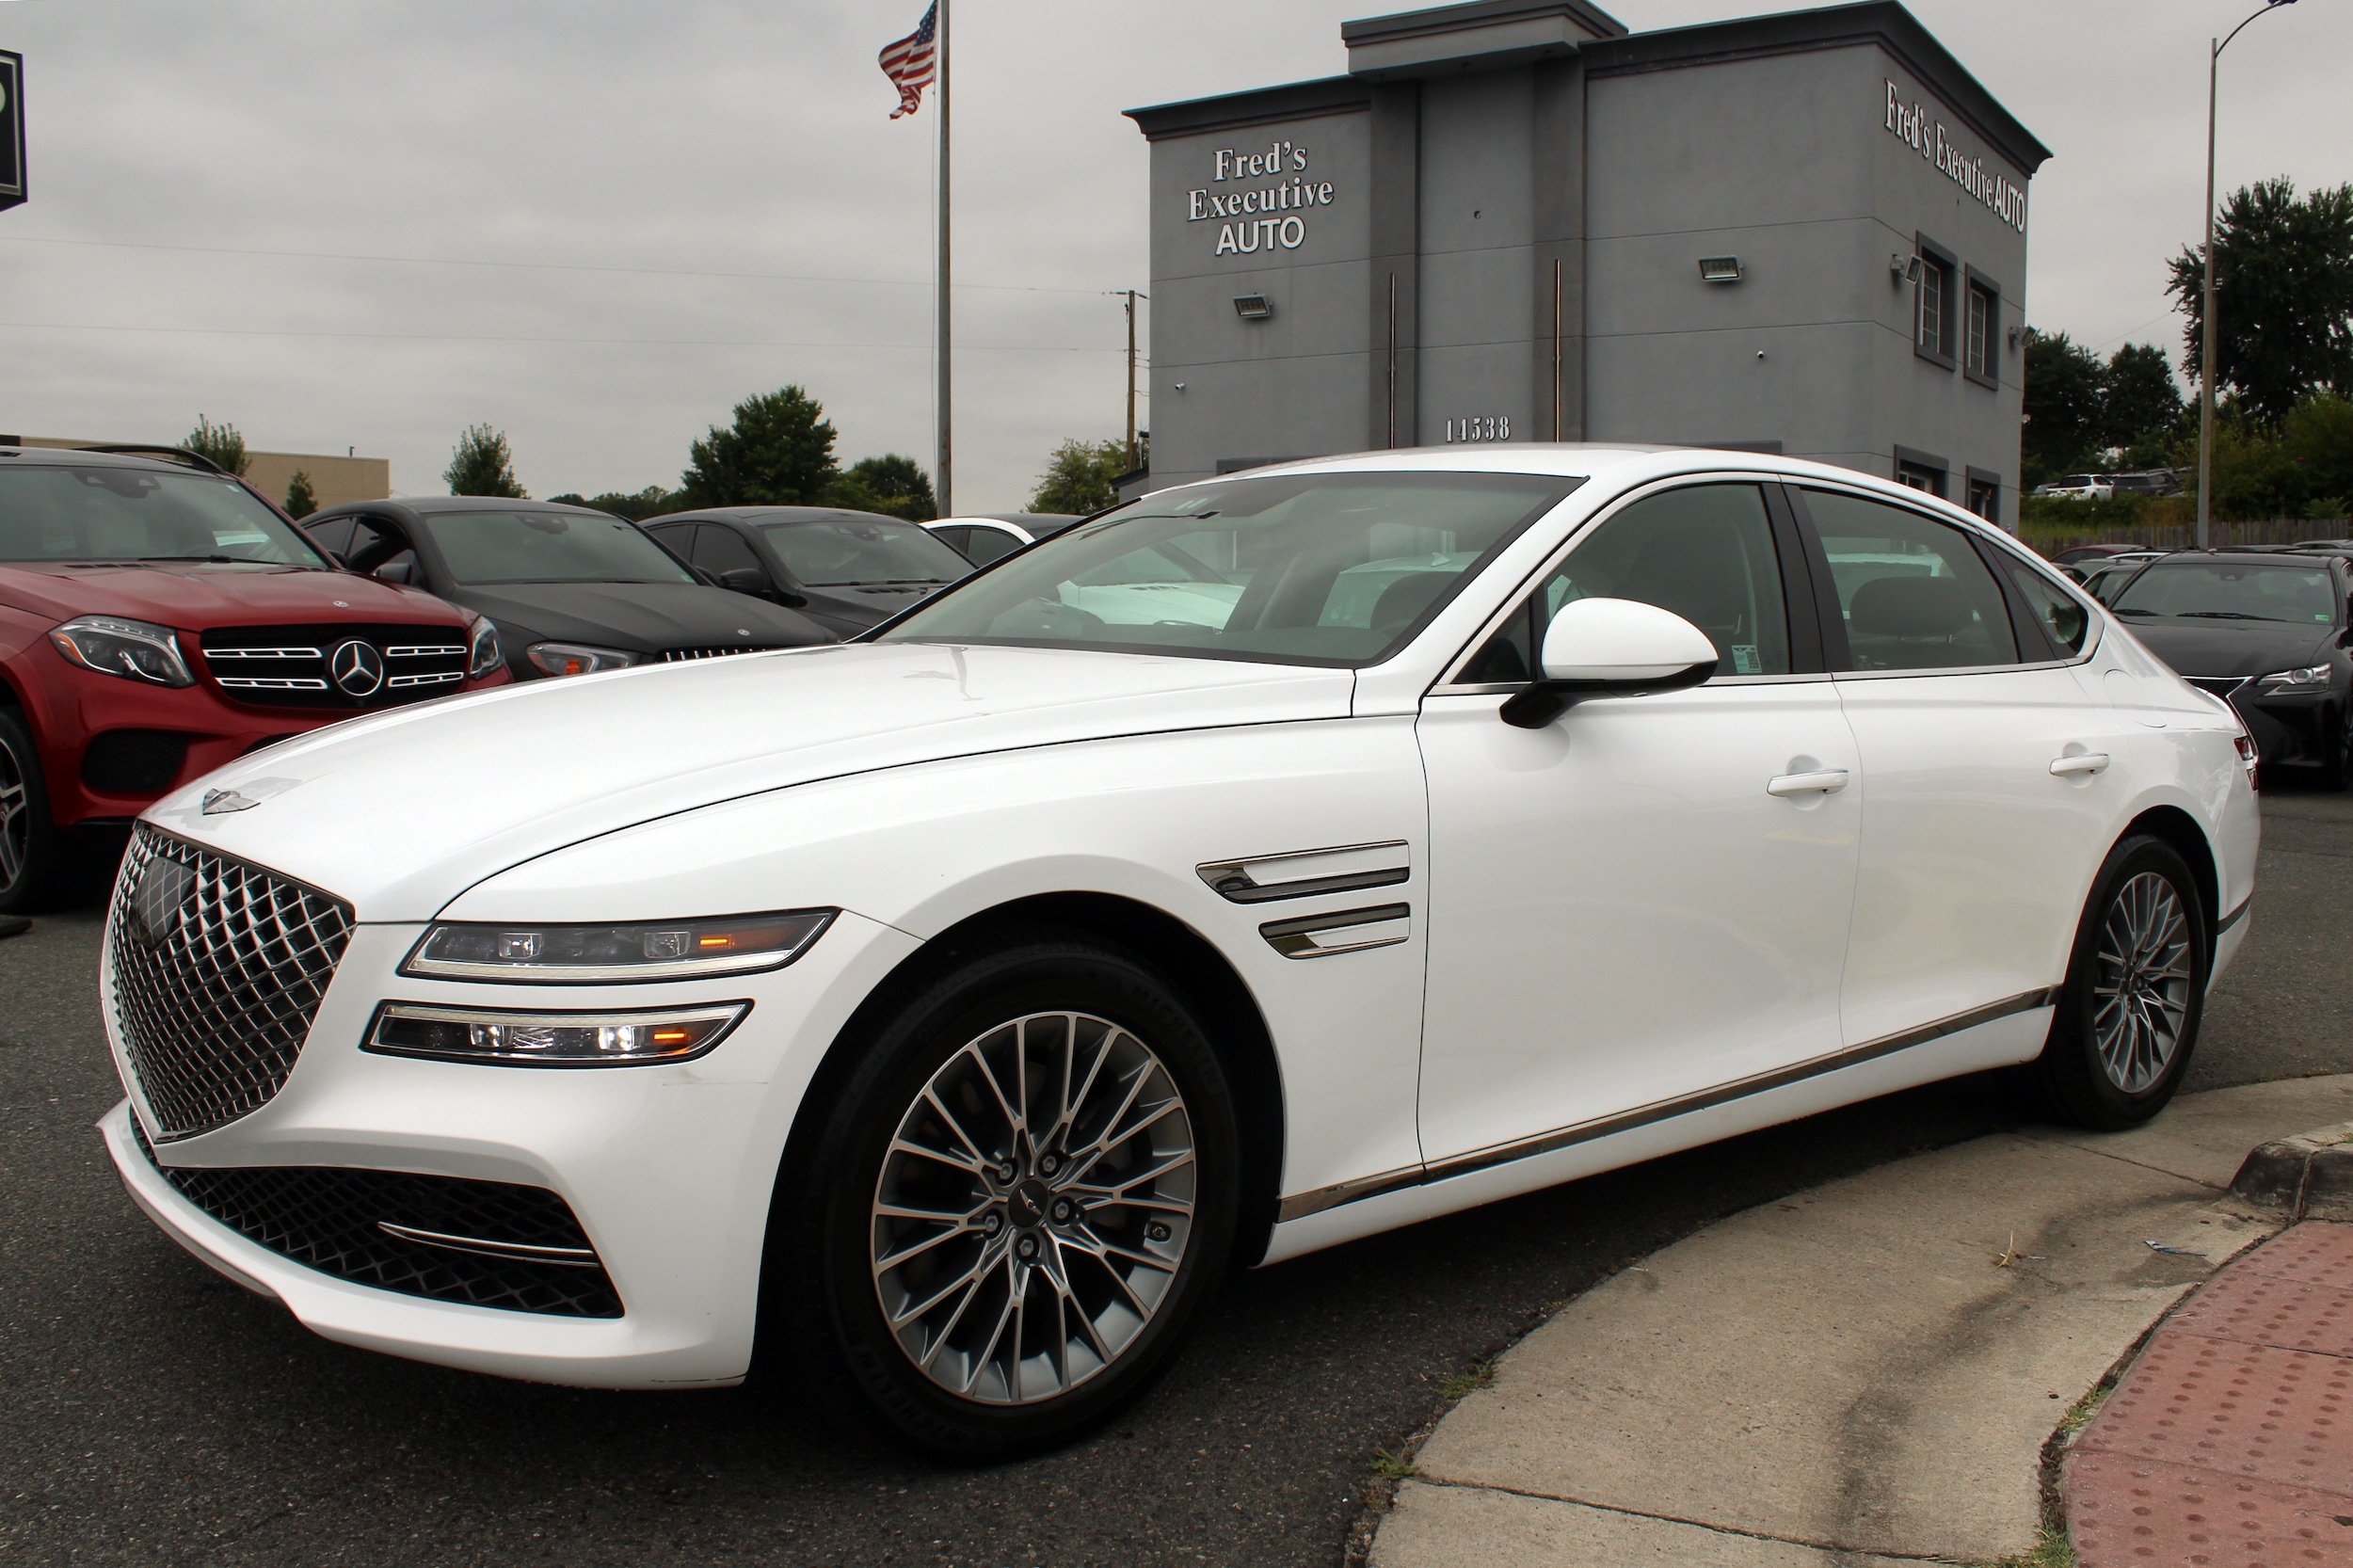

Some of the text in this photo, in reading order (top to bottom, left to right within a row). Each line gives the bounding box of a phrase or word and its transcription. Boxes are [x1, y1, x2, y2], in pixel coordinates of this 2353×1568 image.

[1212, 140, 1307, 182] Fred's
[1885, 77, 2025, 233] Fred's Executive AUTO
[1187, 176, 1334, 221] Executive
[1215, 216, 1305, 255] AUTO
[1446, 415, 1510, 442] 14538
[1129, 983, 1218, 1088] MICHELIN
